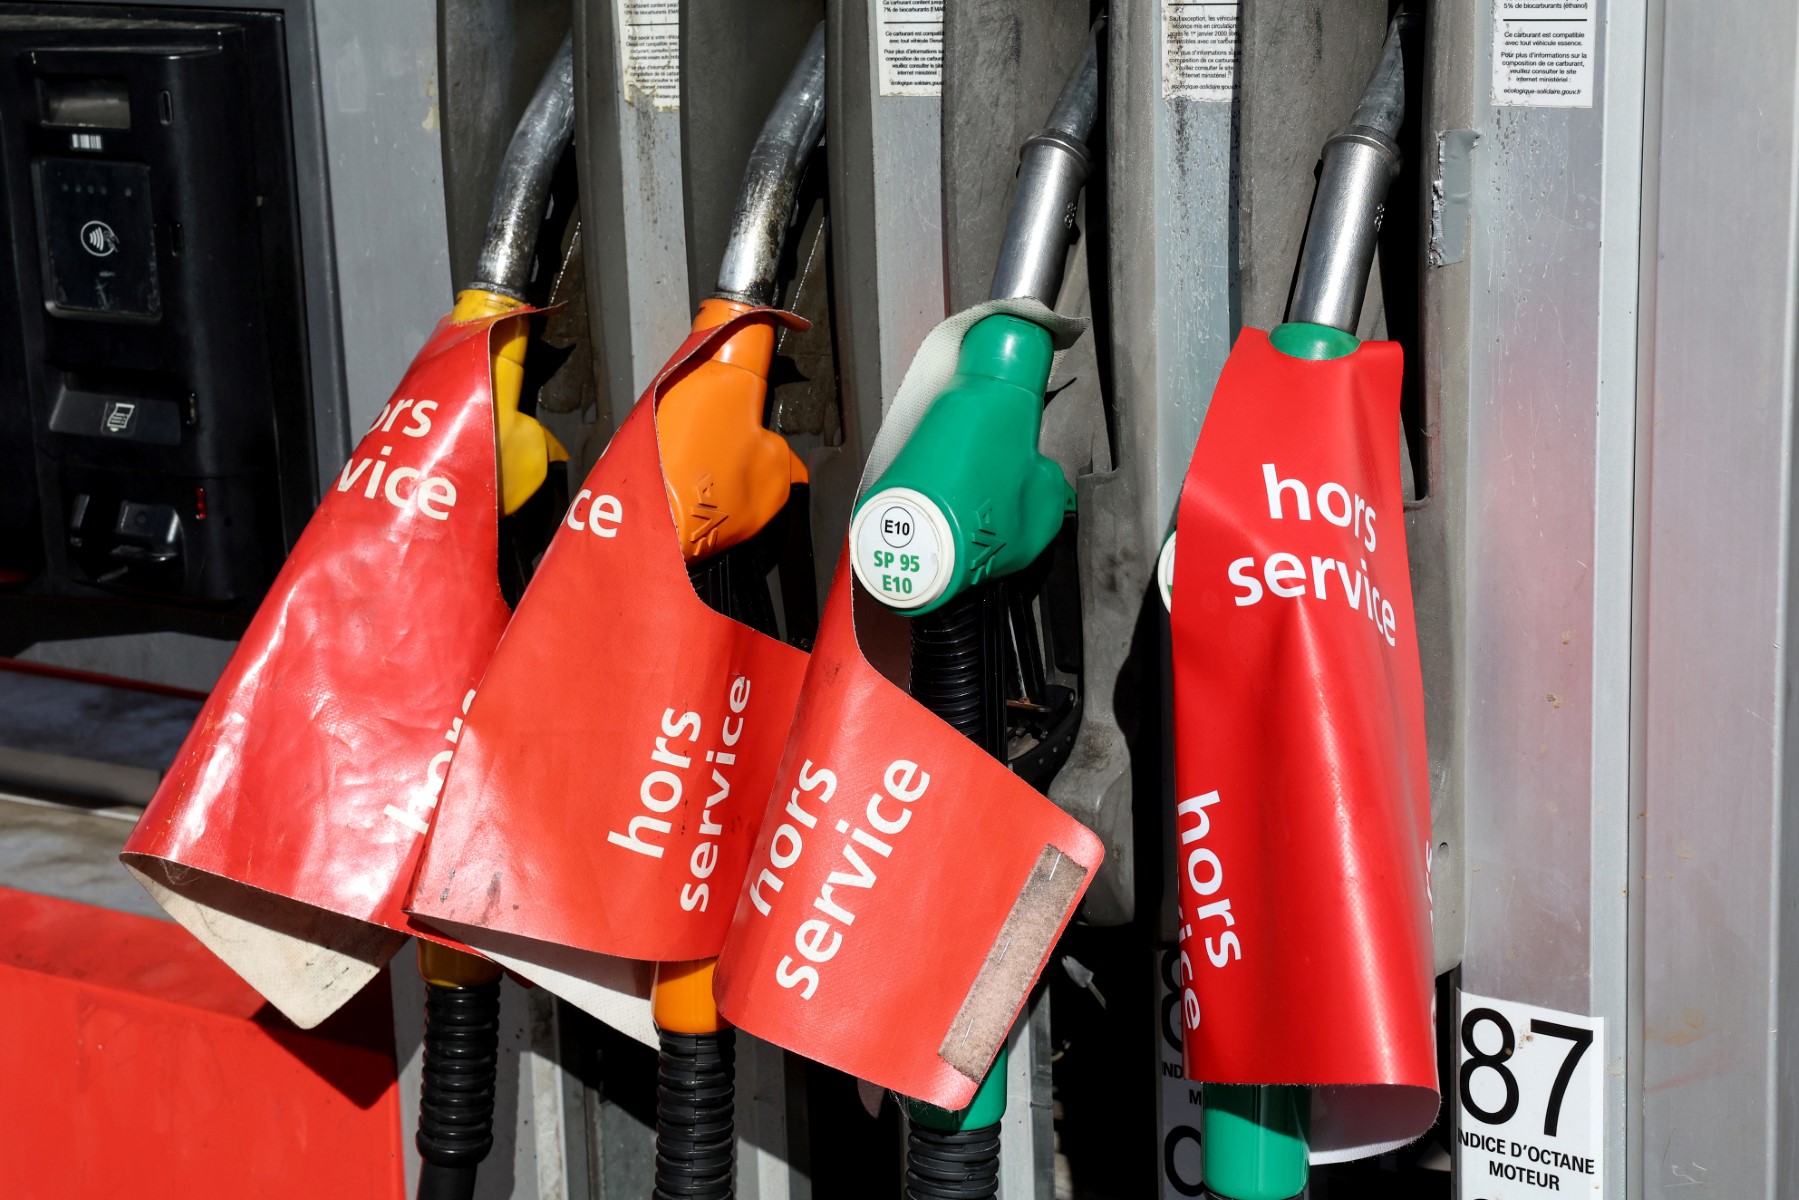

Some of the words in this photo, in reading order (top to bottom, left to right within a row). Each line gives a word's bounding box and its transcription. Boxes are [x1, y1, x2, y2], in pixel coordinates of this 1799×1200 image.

[884, 519, 910, 536] E10
[1262, 463, 1376, 553] hors
[874, 550, 894, 568] SP
[900, 554, 920, 572] 95
[882, 574, 913, 594] E10
[1227, 552, 1396, 647] service
[606, 707, 701, 859] hors
[680, 676, 751, 913] service
[775, 759, 931, 1001] service
[1178, 790, 1242, 968] hors
[1460, 1008, 1594, 1138] 87
[1489, 1160, 1560, 1192] MOTEUR
[1511, 1142, 1595, 1175] D'OCTANE
